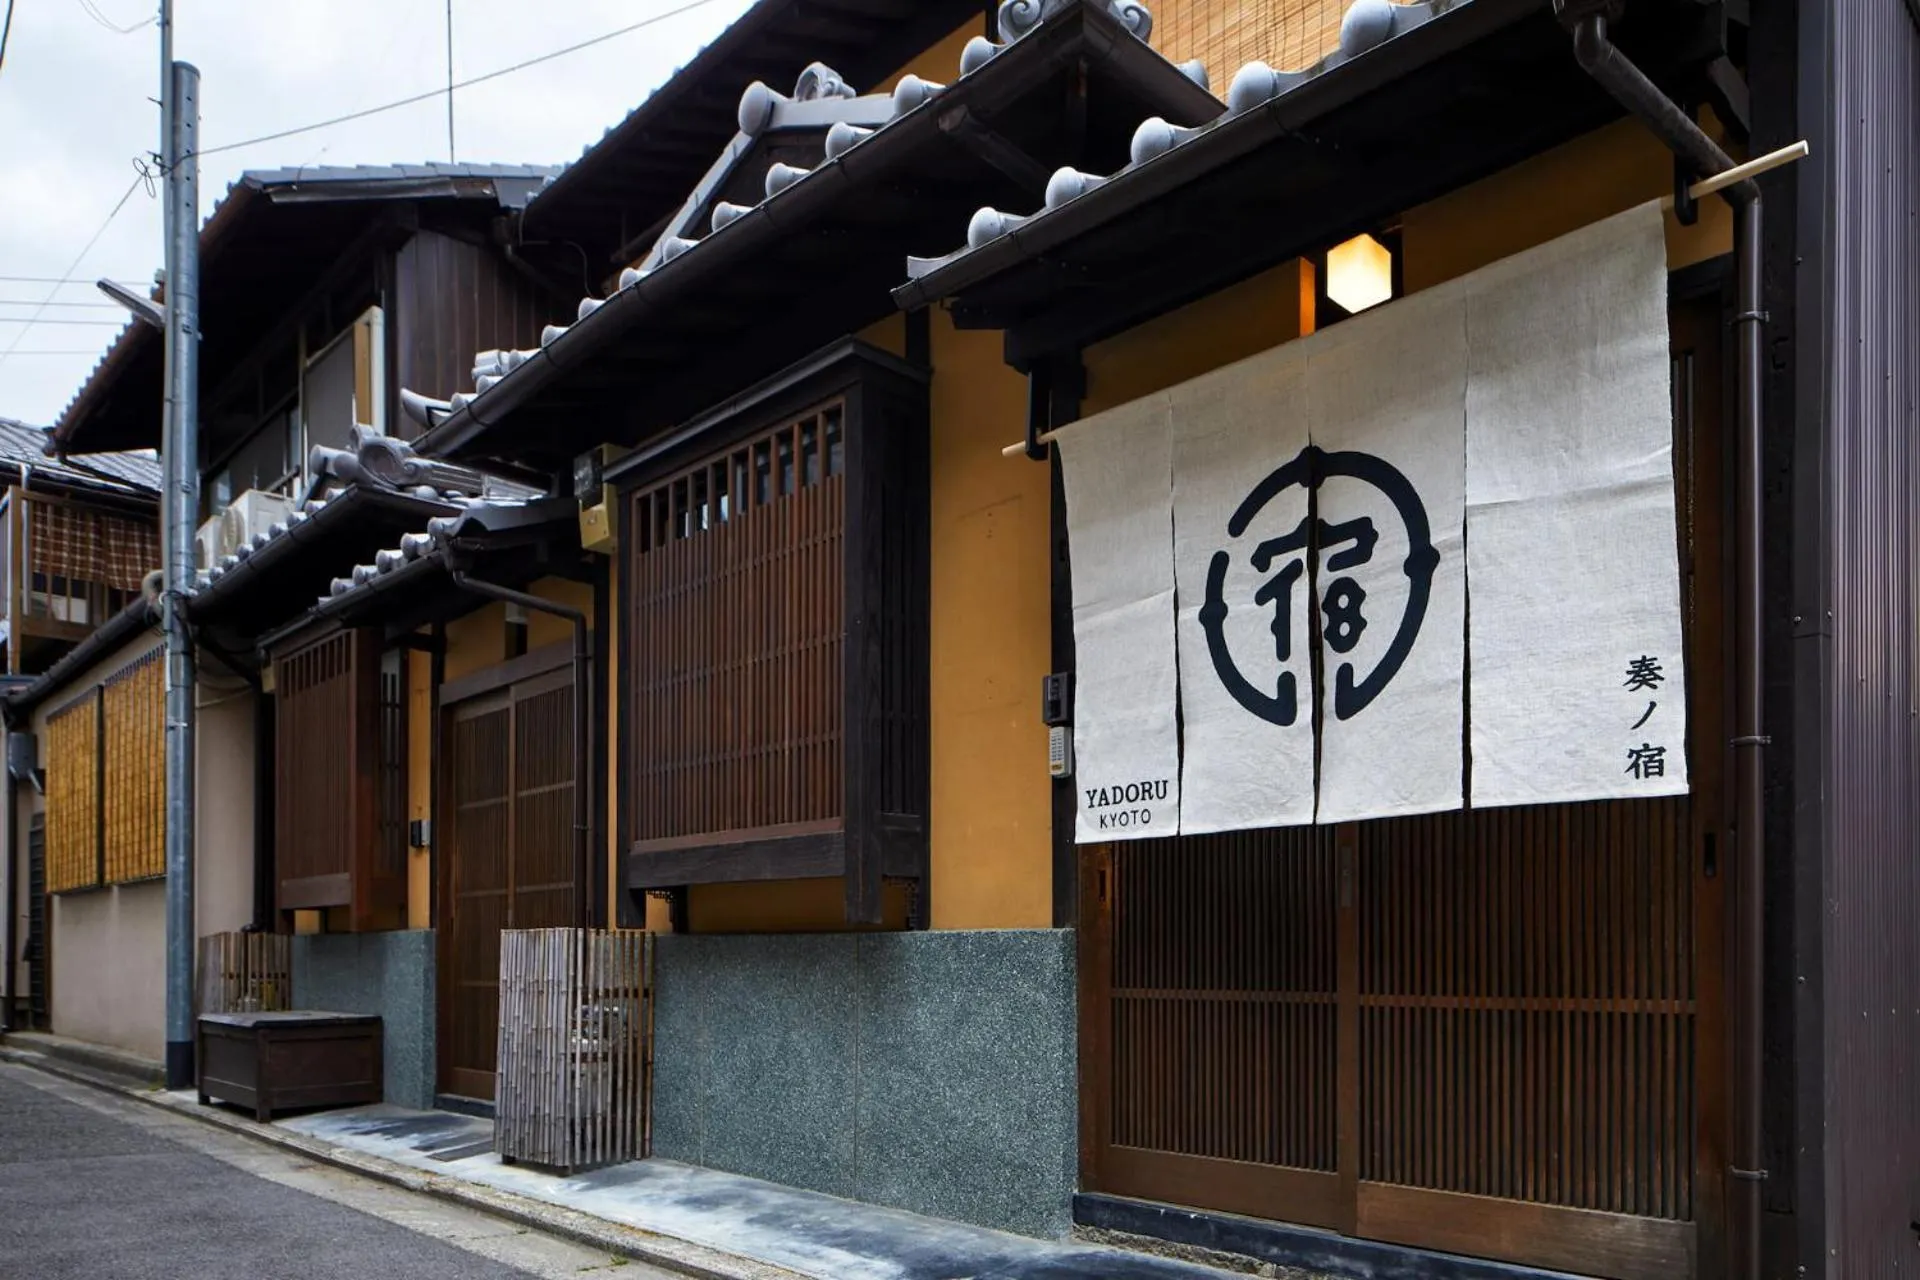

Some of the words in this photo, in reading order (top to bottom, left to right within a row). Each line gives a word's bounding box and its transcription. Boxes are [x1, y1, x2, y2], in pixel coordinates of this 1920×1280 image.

[1622, 655, 1667, 780] 奏ノ宿
[1085, 779, 1168, 808] YADORU
[1100, 808, 1151, 829] KYOTO
